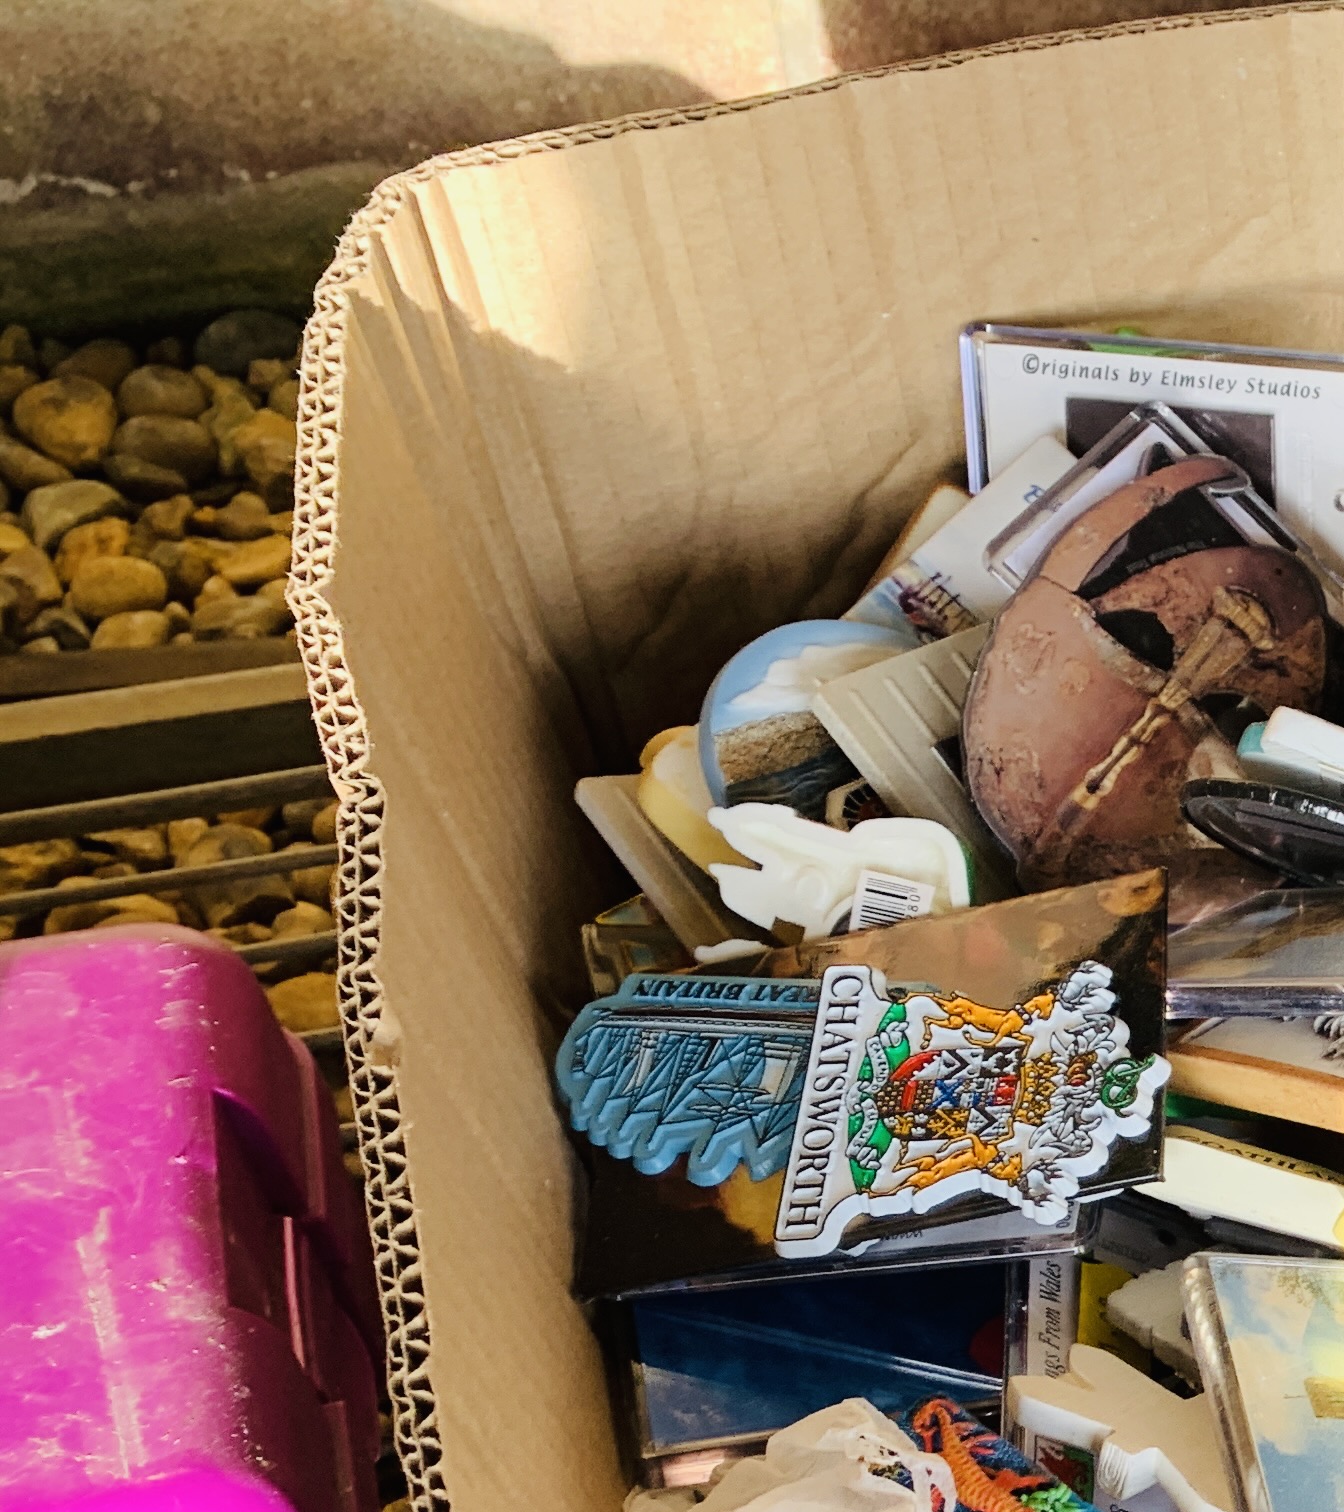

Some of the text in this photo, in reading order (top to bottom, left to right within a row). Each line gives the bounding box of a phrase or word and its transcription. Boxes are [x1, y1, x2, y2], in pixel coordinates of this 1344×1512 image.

[1128, 368, 1153, 388] by
[1160, 369, 1238, 396] Elmsley
[1244, 376, 1323, 400] Studios
[632, 979, 747, 1002] BRITAIN
[783, 974, 848, 1235] CHATSWORTH
[1038, 1259, 1064, 1306] Wales
[1037, 1303, 1062, 1353] From
